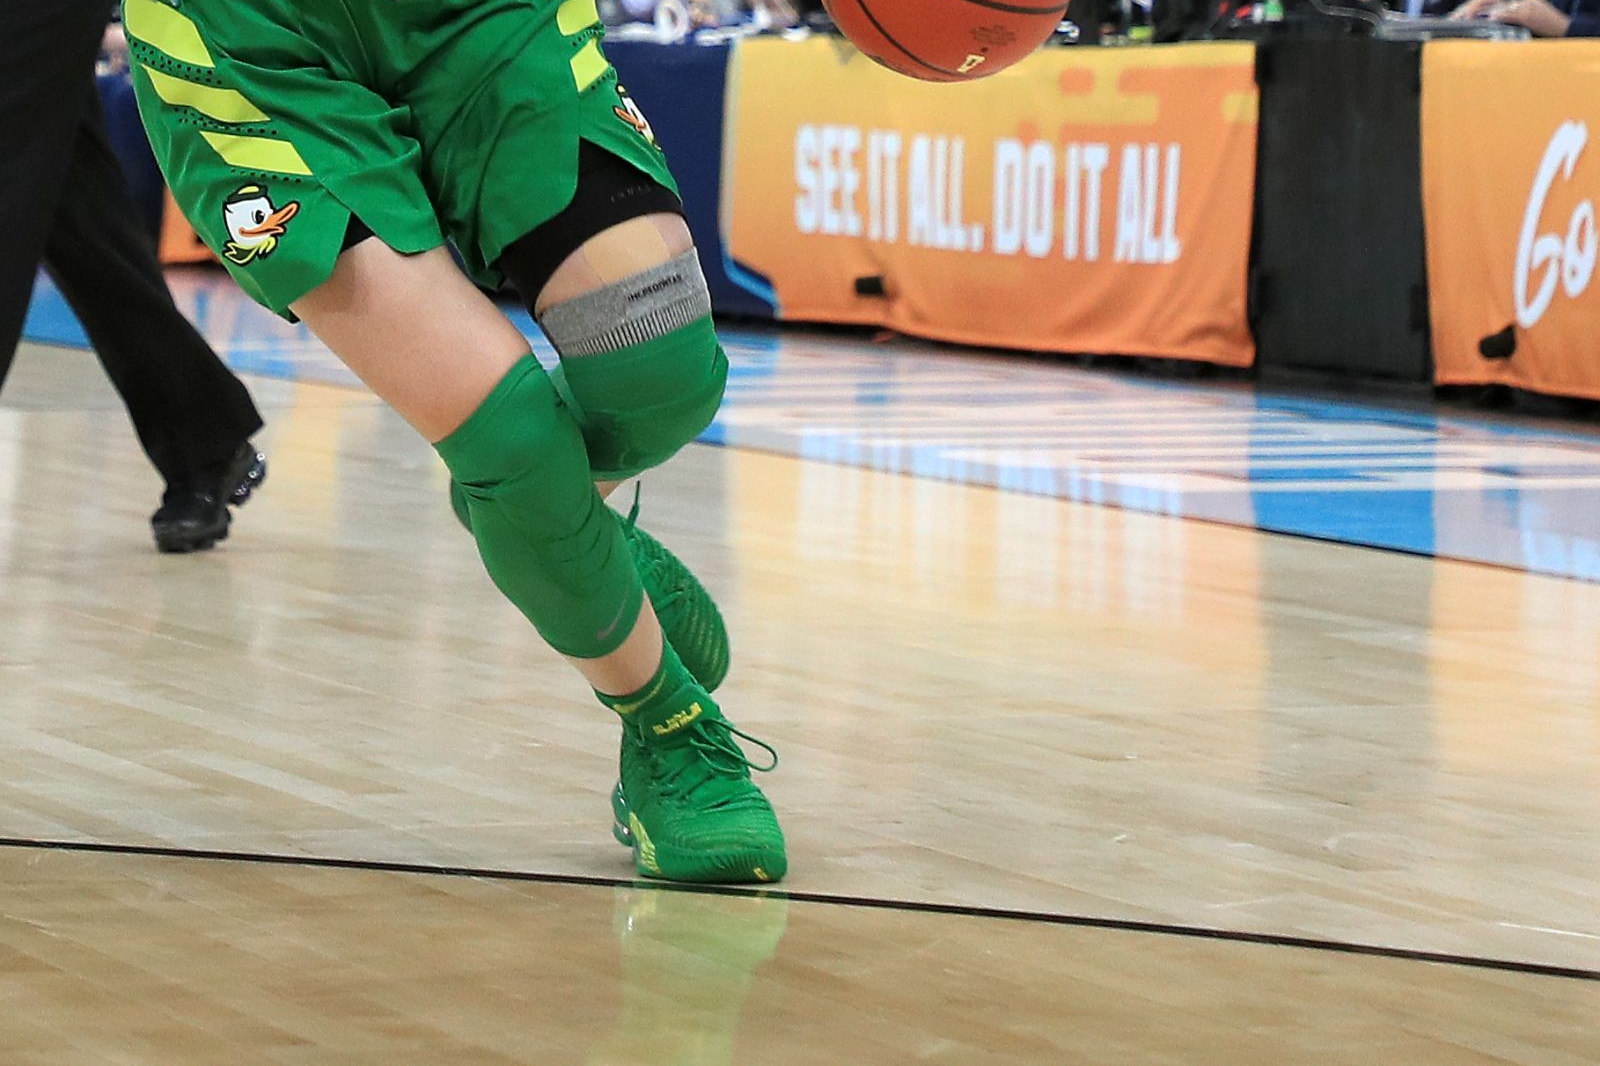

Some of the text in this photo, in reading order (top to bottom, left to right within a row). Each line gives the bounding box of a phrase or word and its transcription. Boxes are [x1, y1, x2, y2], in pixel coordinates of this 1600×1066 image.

[795, 123, 1182, 265] SEE IT ALL. DO IT ALL
